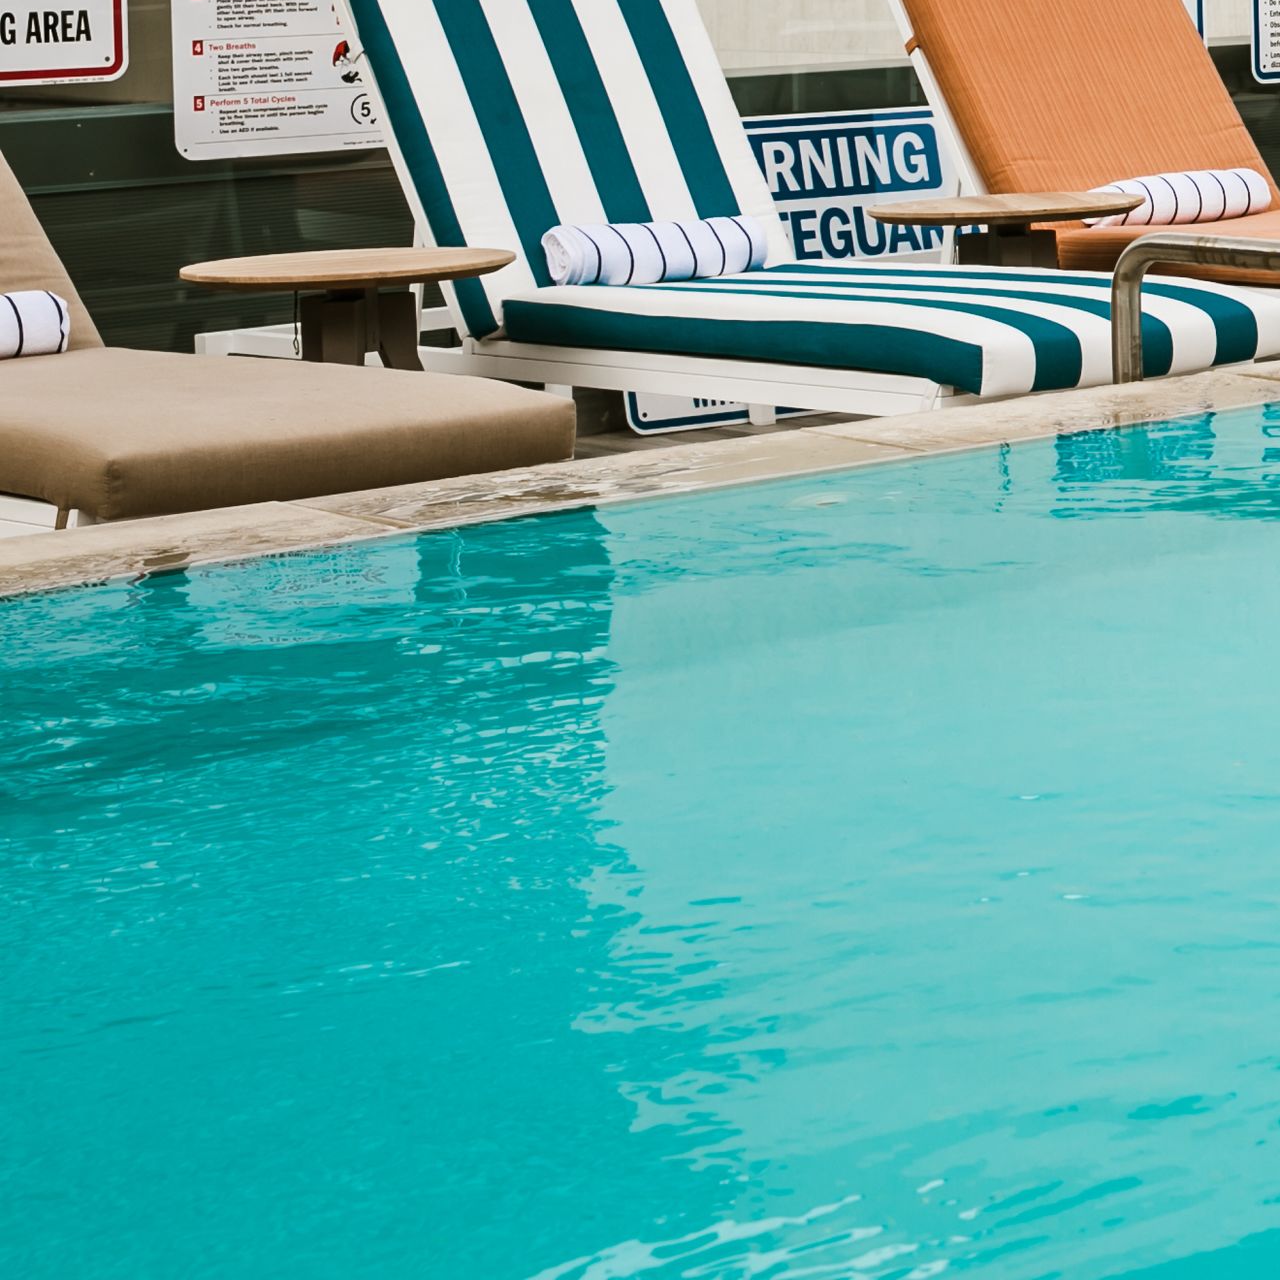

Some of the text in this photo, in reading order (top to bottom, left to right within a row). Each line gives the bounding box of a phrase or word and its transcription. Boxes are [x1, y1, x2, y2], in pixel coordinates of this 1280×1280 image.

[26, 10, 92, 44] AREA
[194, 42, 201, 53] 4
[226, 42, 256, 51] Breaths
[196, 98, 203, 108] 5
[210, 99, 241, 108] Perform
[251, 97, 269, 105] Total
[271, 96, 296, 105] Cycles
[361, 101, 371, 117] 5
[762, 131, 930, 193] RNING
